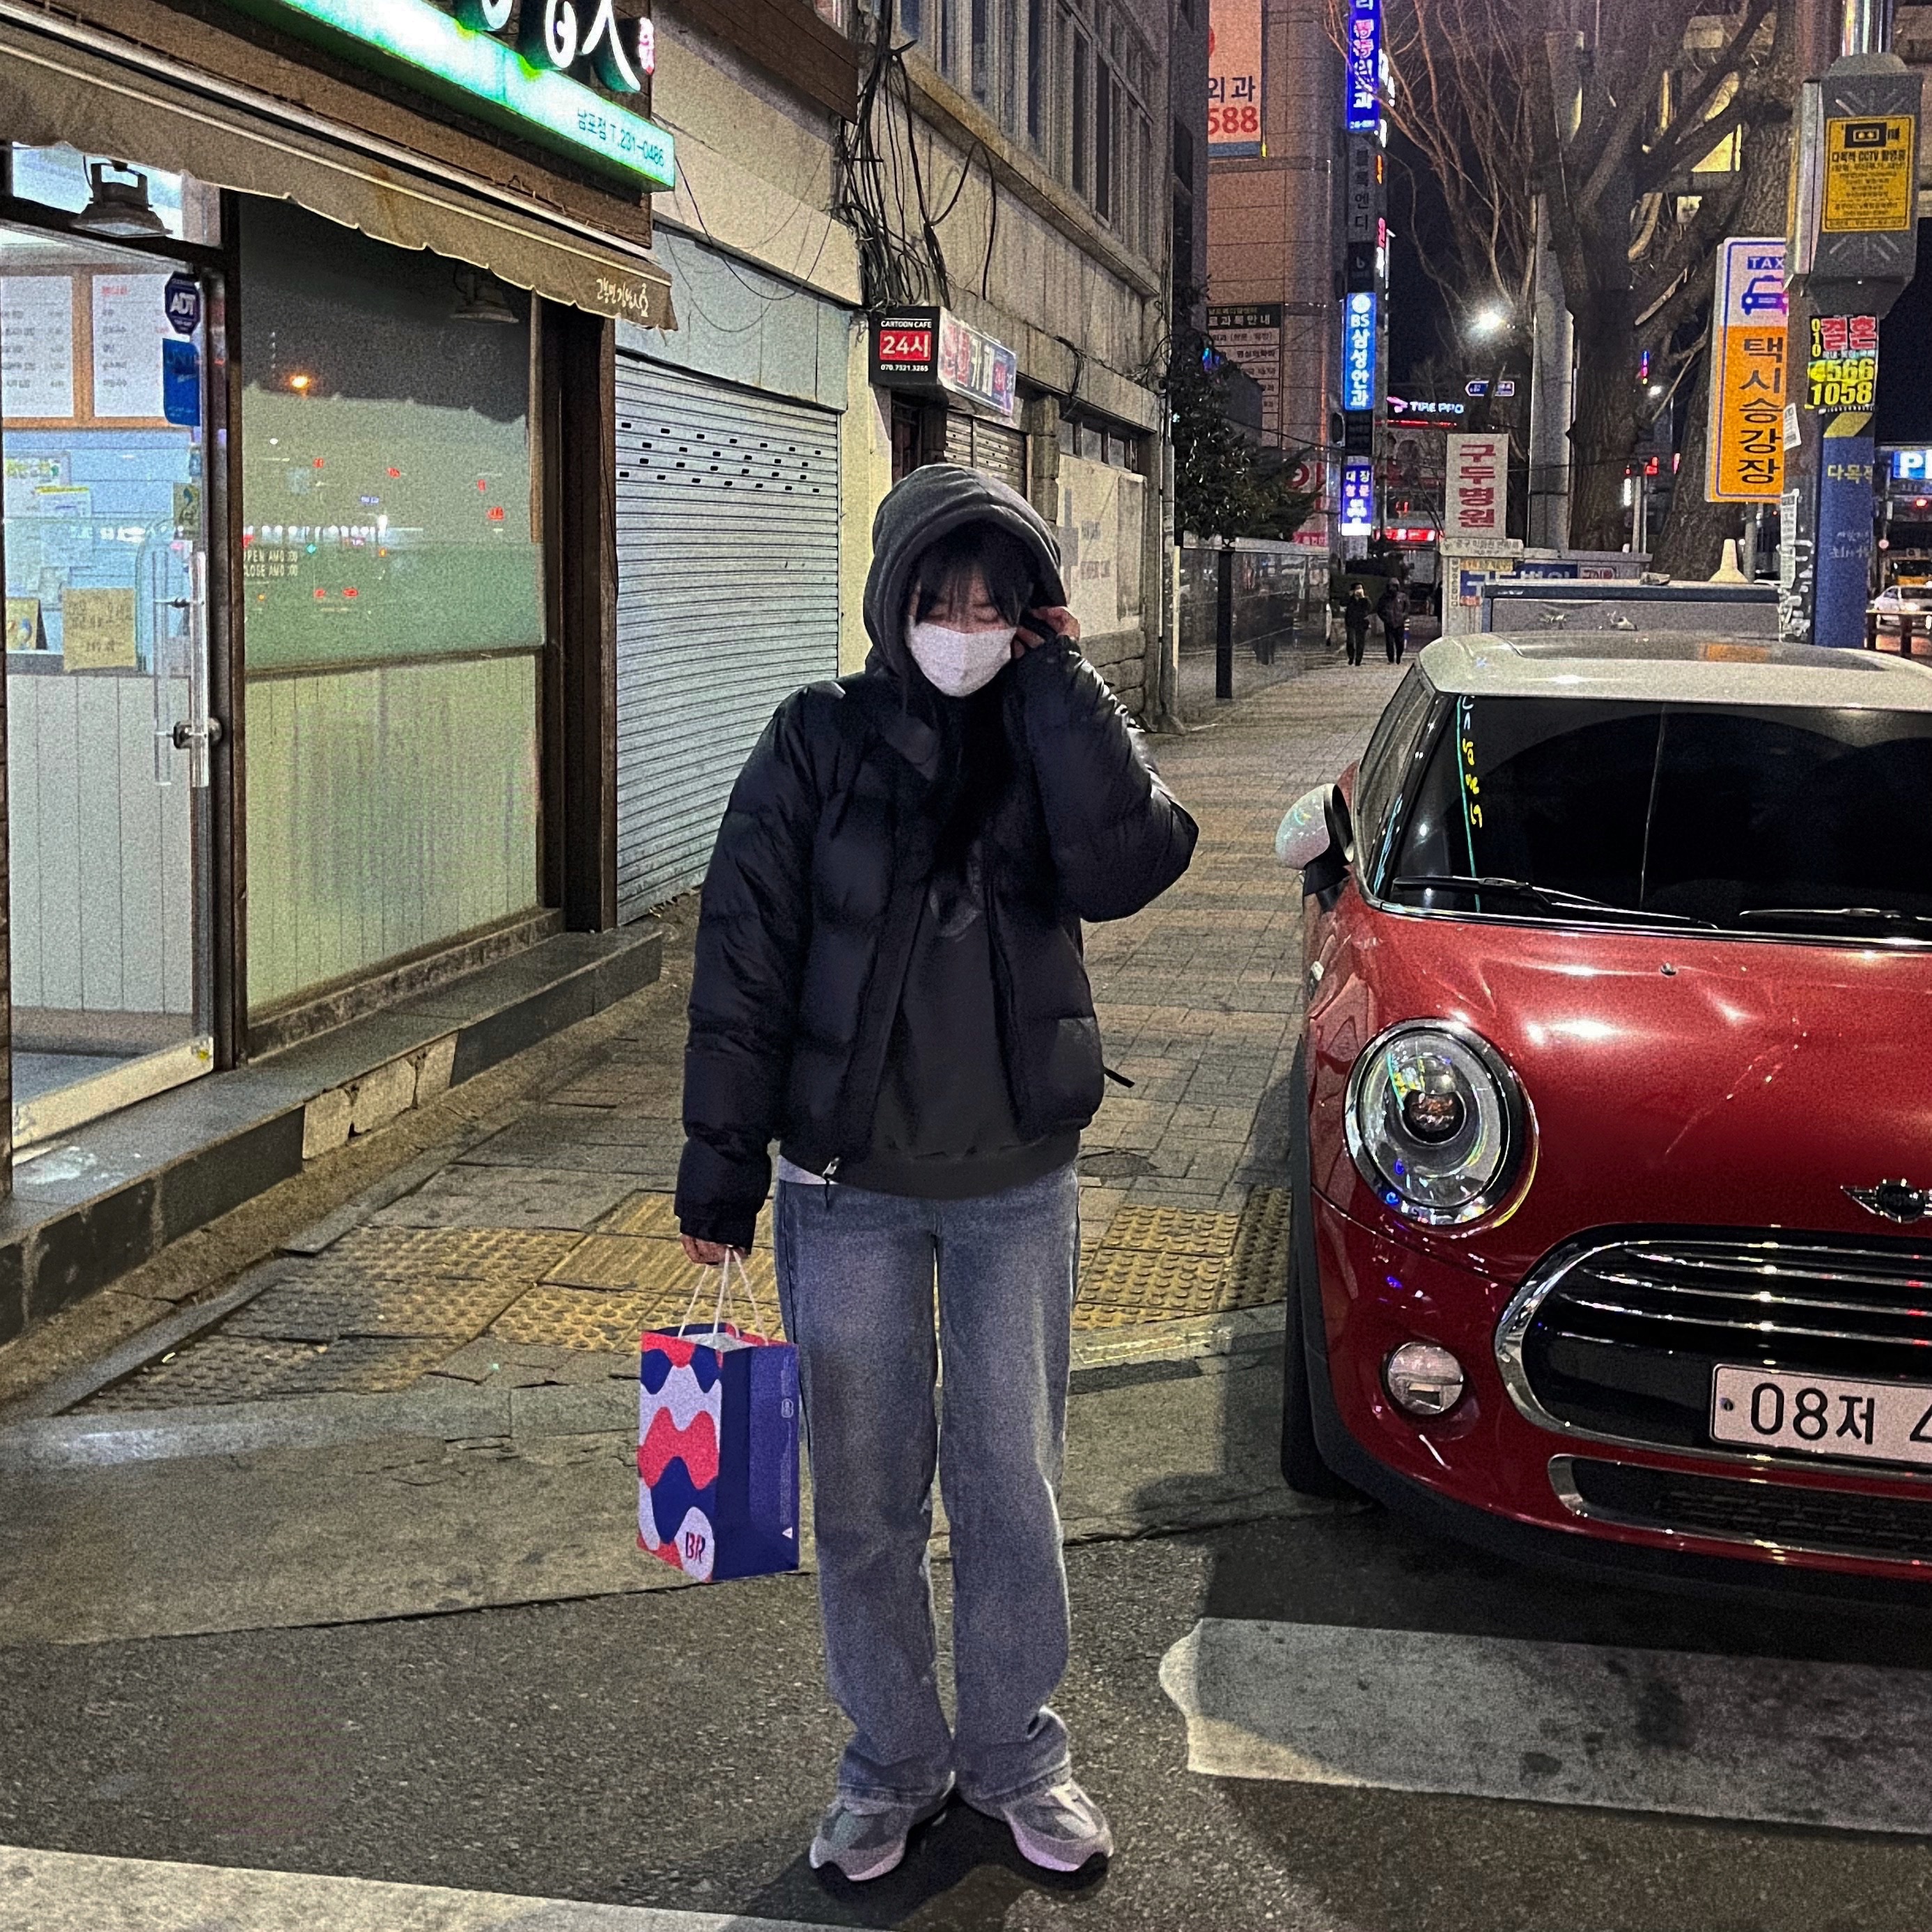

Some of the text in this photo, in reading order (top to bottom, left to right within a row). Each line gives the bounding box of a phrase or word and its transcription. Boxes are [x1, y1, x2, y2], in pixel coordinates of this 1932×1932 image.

[1858, 150, 1879, 162] CCTV
[170, 291, 196, 315] ADT
[882, 334, 929, 358] 24시
[1821, 315, 1876, 351] 결혼
[1410, 401, 1436, 413] TIRE
[1811, 381, 1873, 406] 1058
[1737, 336, 1784, 485] 택시승강장
[1458, 444, 1496, 529] 구두병원
[1750, 1382, 1875, 1445] 08저
[685, 1532, 706, 1563] BR
